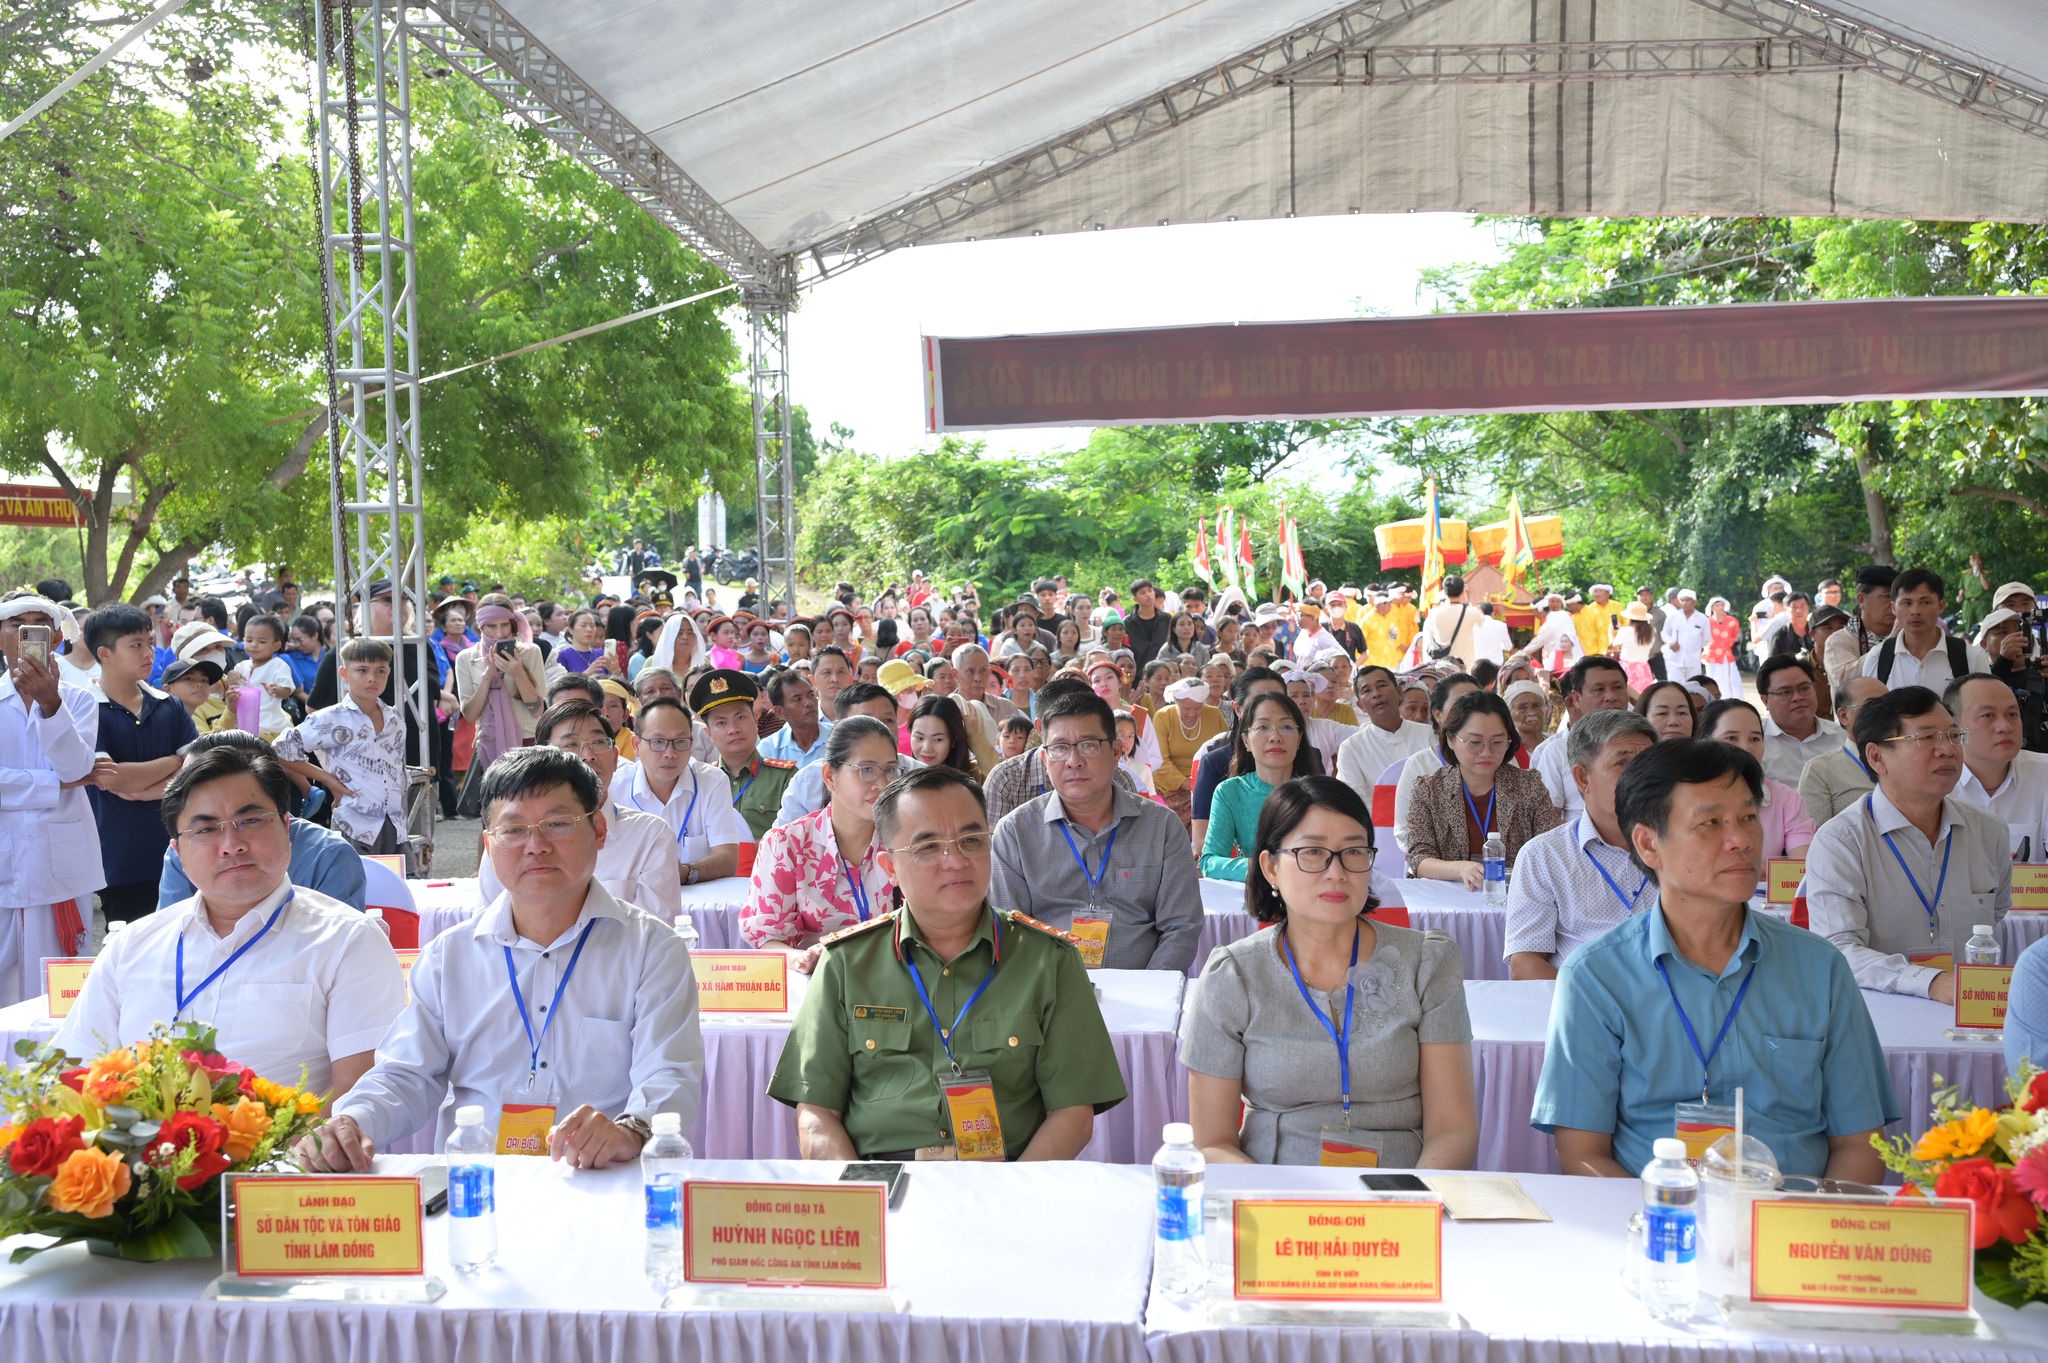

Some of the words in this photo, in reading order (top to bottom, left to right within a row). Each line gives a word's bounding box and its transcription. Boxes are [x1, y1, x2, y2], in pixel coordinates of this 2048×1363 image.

[5, 491, 24, 516] VÀ
[736, 980, 762, 994] THUẬN
[332, 1196, 356, 1209] ĐẠO
[745, 1199, 773, 1213] ĐỒNG
[775, 1202, 792, 1214] CHÍ
[794, 1203, 811, 1216] ĐẠI
[814, 1202, 826, 1215] TÁ
[256, 1214, 273, 1234] SỞ
[276, 1216, 300, 1233] DÂN
[303, 1216, 325, 1236] TỘC
[328, 1215, 343, 1233] VÀ
[347, 1216, 370, 1233] TÔN
[373, 1215, 401, 1232] GIÁO
[1308, 1213, 1341, 1226] ĐỒNG
[1345, 1213, 1365, 1226] CHÍ
[1831, 1216, 1866, 1230] ĐỒNG
[1869, 1219, 1891, 1231] CHÍ
[712, 1223, 767, 1245] HUỲNH
[771, 1228, 816, 1249] NGỌC
[821, 1226, 861, 1248] LIÊM
[283, 1239, 311, 1259] TỈNH
[314, 1241, 340, 1258] LÂM
[343, 1239, 375, 1258] ĐỒNG
[1275, 1237, 1293, 1256] LÊ
[1296, 1241, 1319, 1260] THỊ
[1323, 1236, 1347, 1257] HẢI
[1854, 1243, 1886, 1262] VĂN
[711, 1256, 727, 1266] PHÓ
[729, 1257, 749, 1267] GIÁM
[767, 1257, 789, 1268] CÔNG
[790, 1260, 801, 1269] AN
[822, 1259, 839, 1270] LÂM
